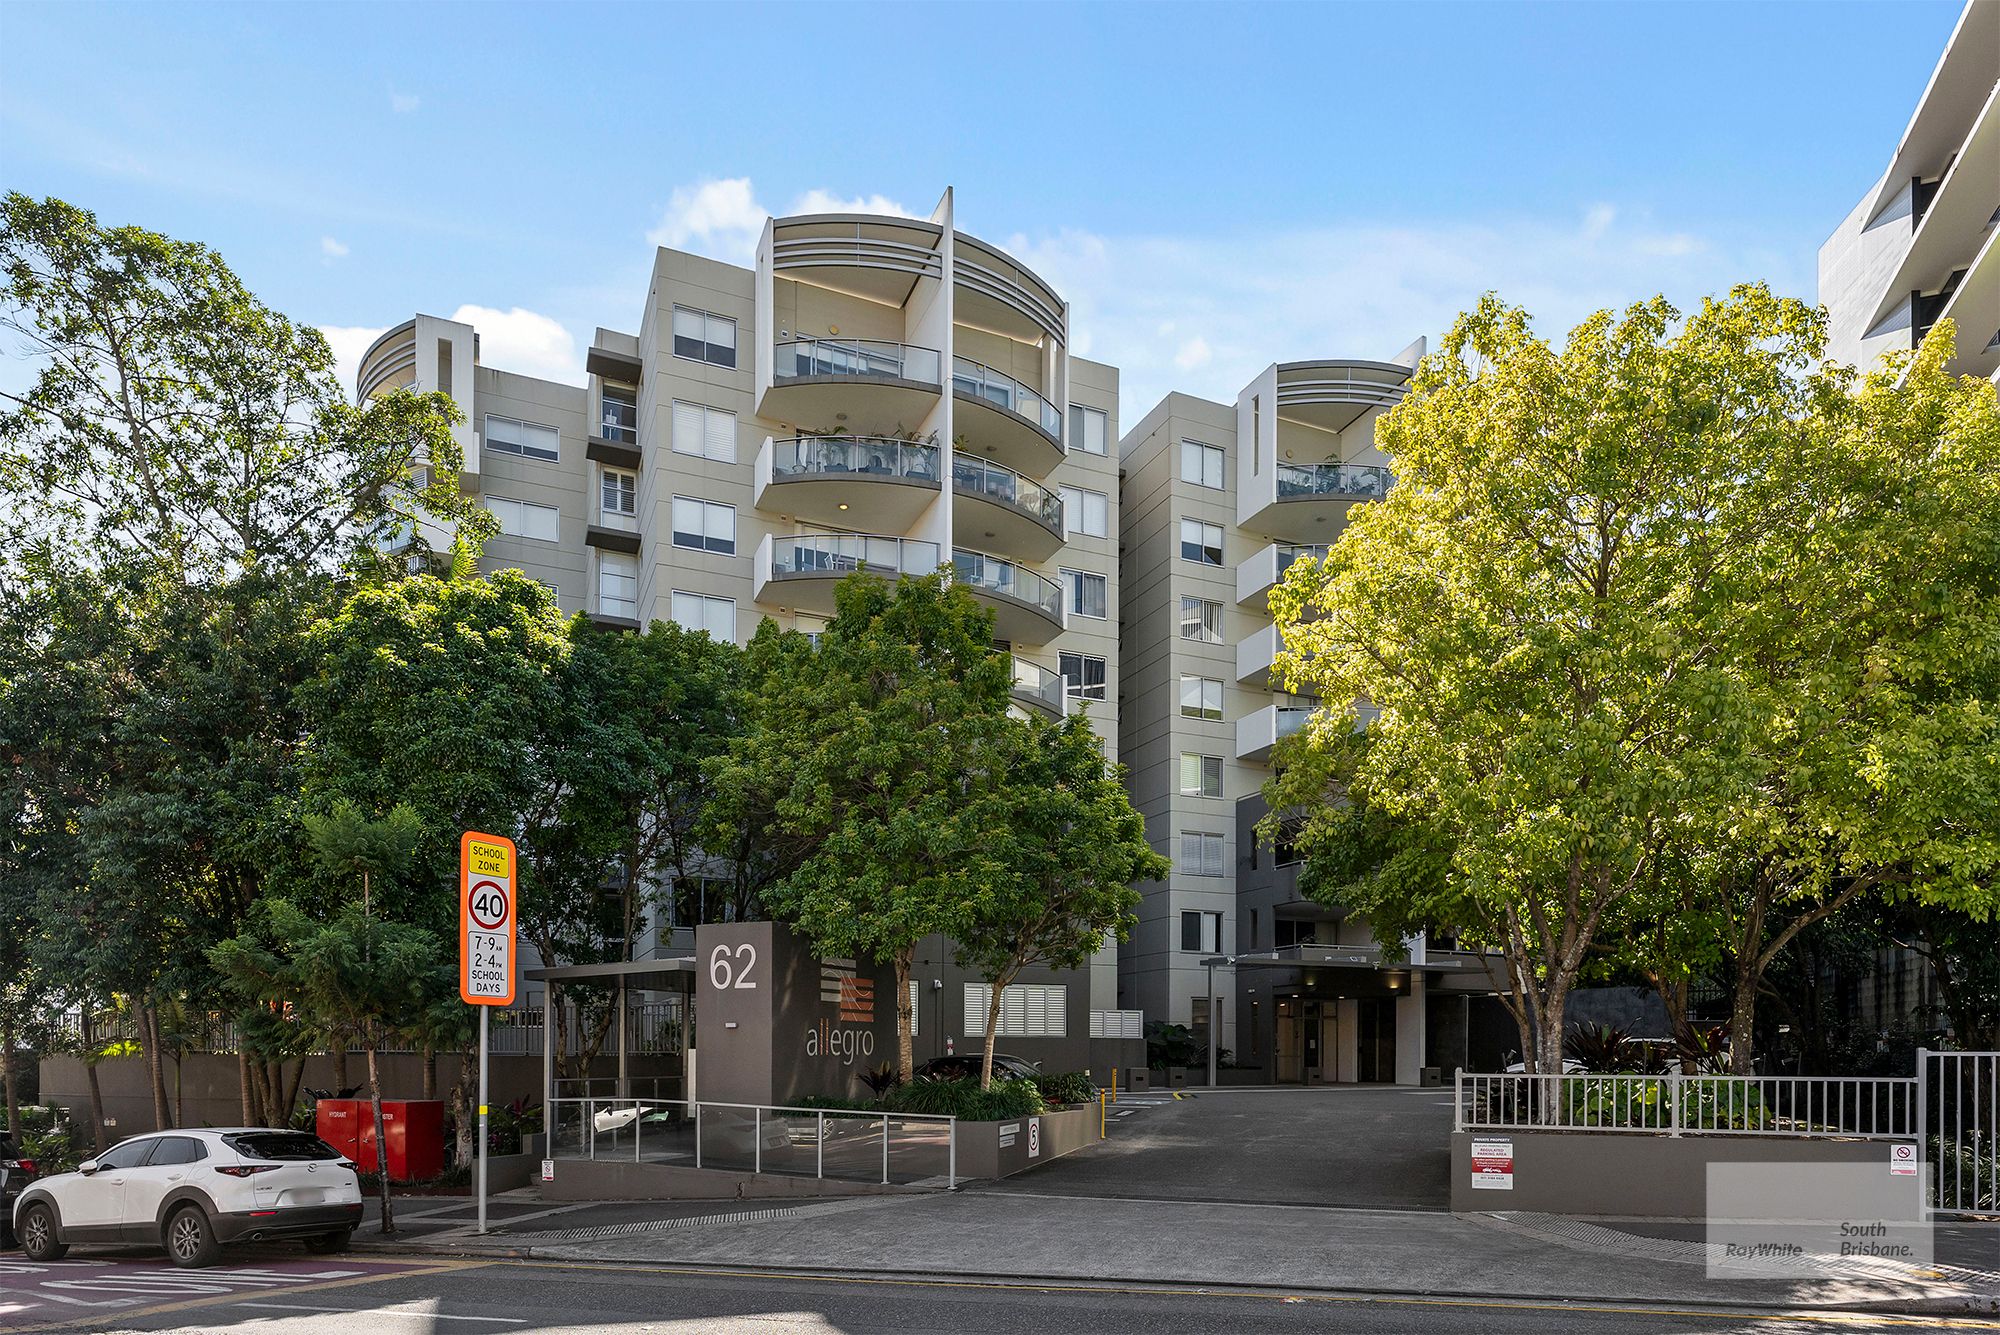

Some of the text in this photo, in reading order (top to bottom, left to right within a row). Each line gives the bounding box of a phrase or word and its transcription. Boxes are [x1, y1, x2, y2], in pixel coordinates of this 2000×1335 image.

[473, 846, 505, 860] SCHOOL
[478, 860, 500, 873] ZONE
[474, 893, 503, 918] 40
[710, 943, 757, 990] 62
[472, 970, 505, 981] SCHOOL
[476, 982, 501, 993] DAYS
[806, 1018, 874, 1065] allegro
[1032, 1130, 1037, 1145] 5
